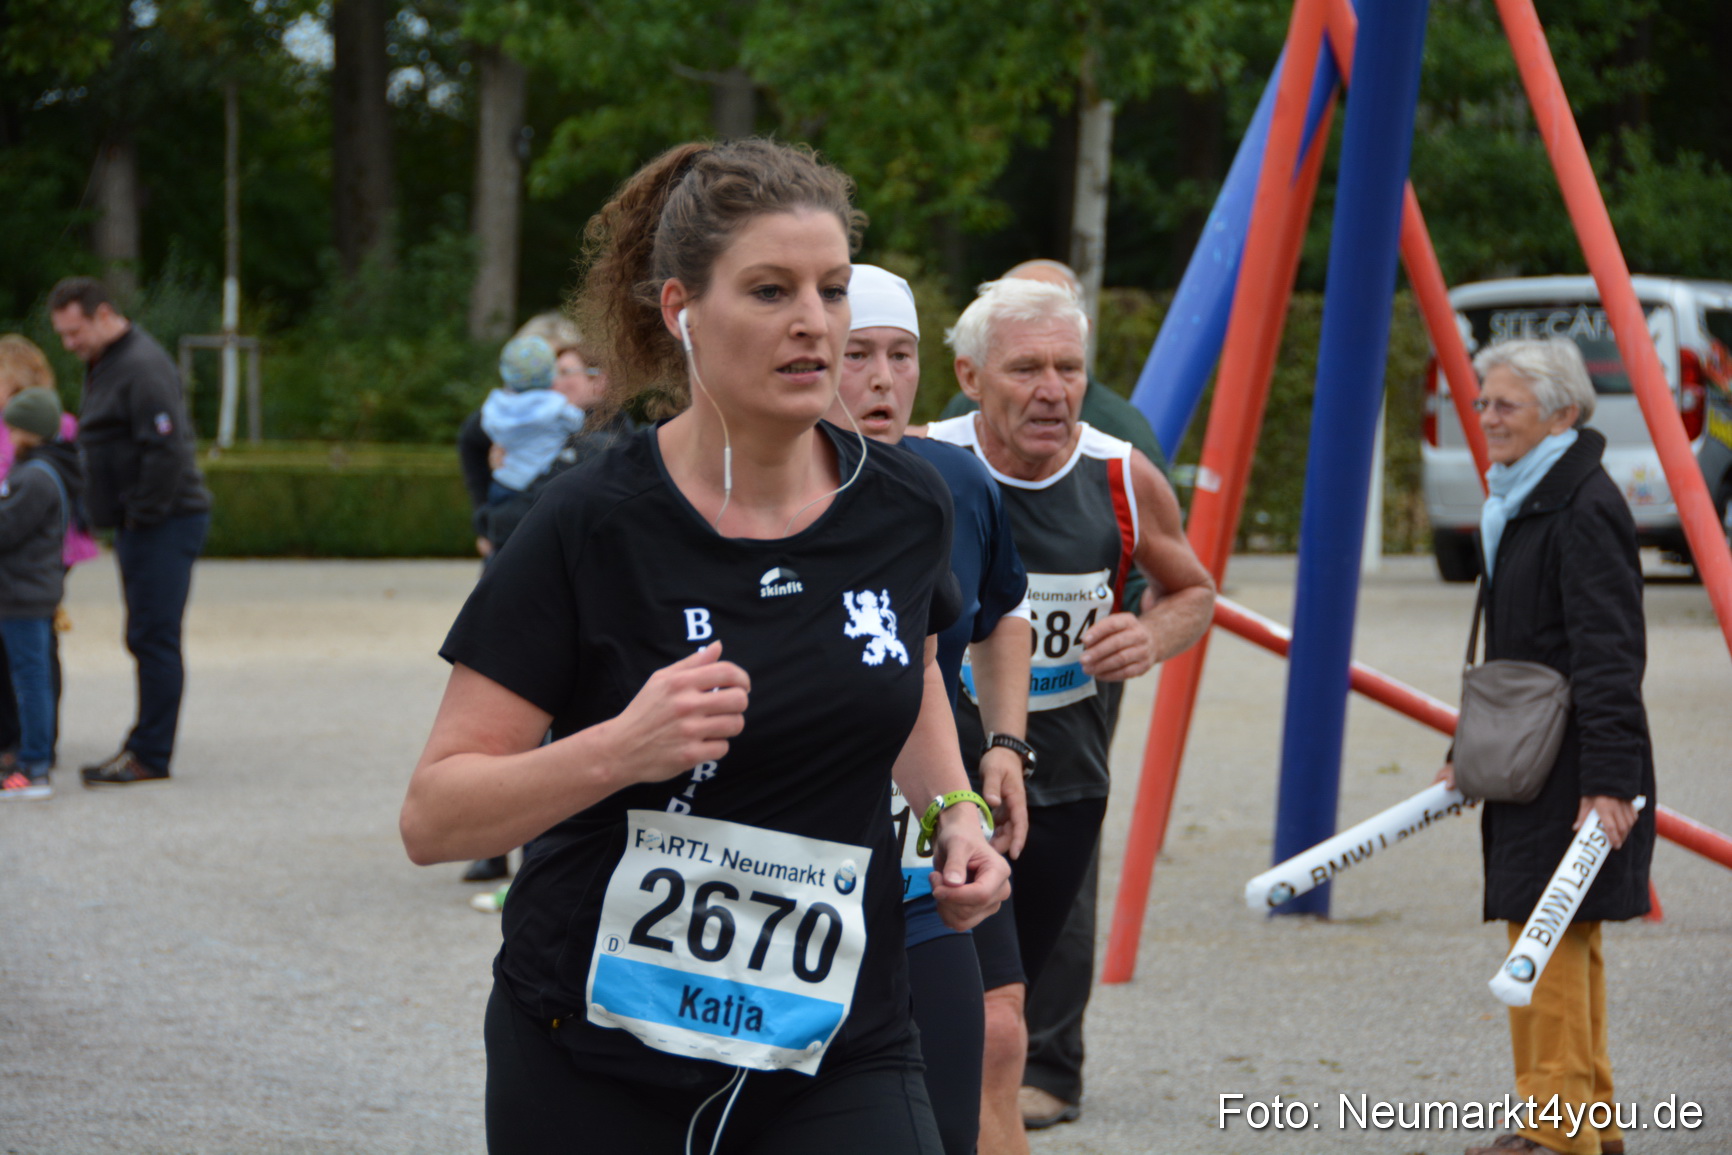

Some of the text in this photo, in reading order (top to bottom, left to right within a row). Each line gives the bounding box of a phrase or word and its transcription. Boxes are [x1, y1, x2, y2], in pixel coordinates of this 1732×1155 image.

[760, 580, 803, 598] skinfit
[719, 847, 826, 888] Neumarkt
[1309, 838, 1374, 886] BMW
[628, 867, 843, 984] 2670
[1527, 886, 1574, 948] BMW
[678, 984, 764, 1036] Katja
